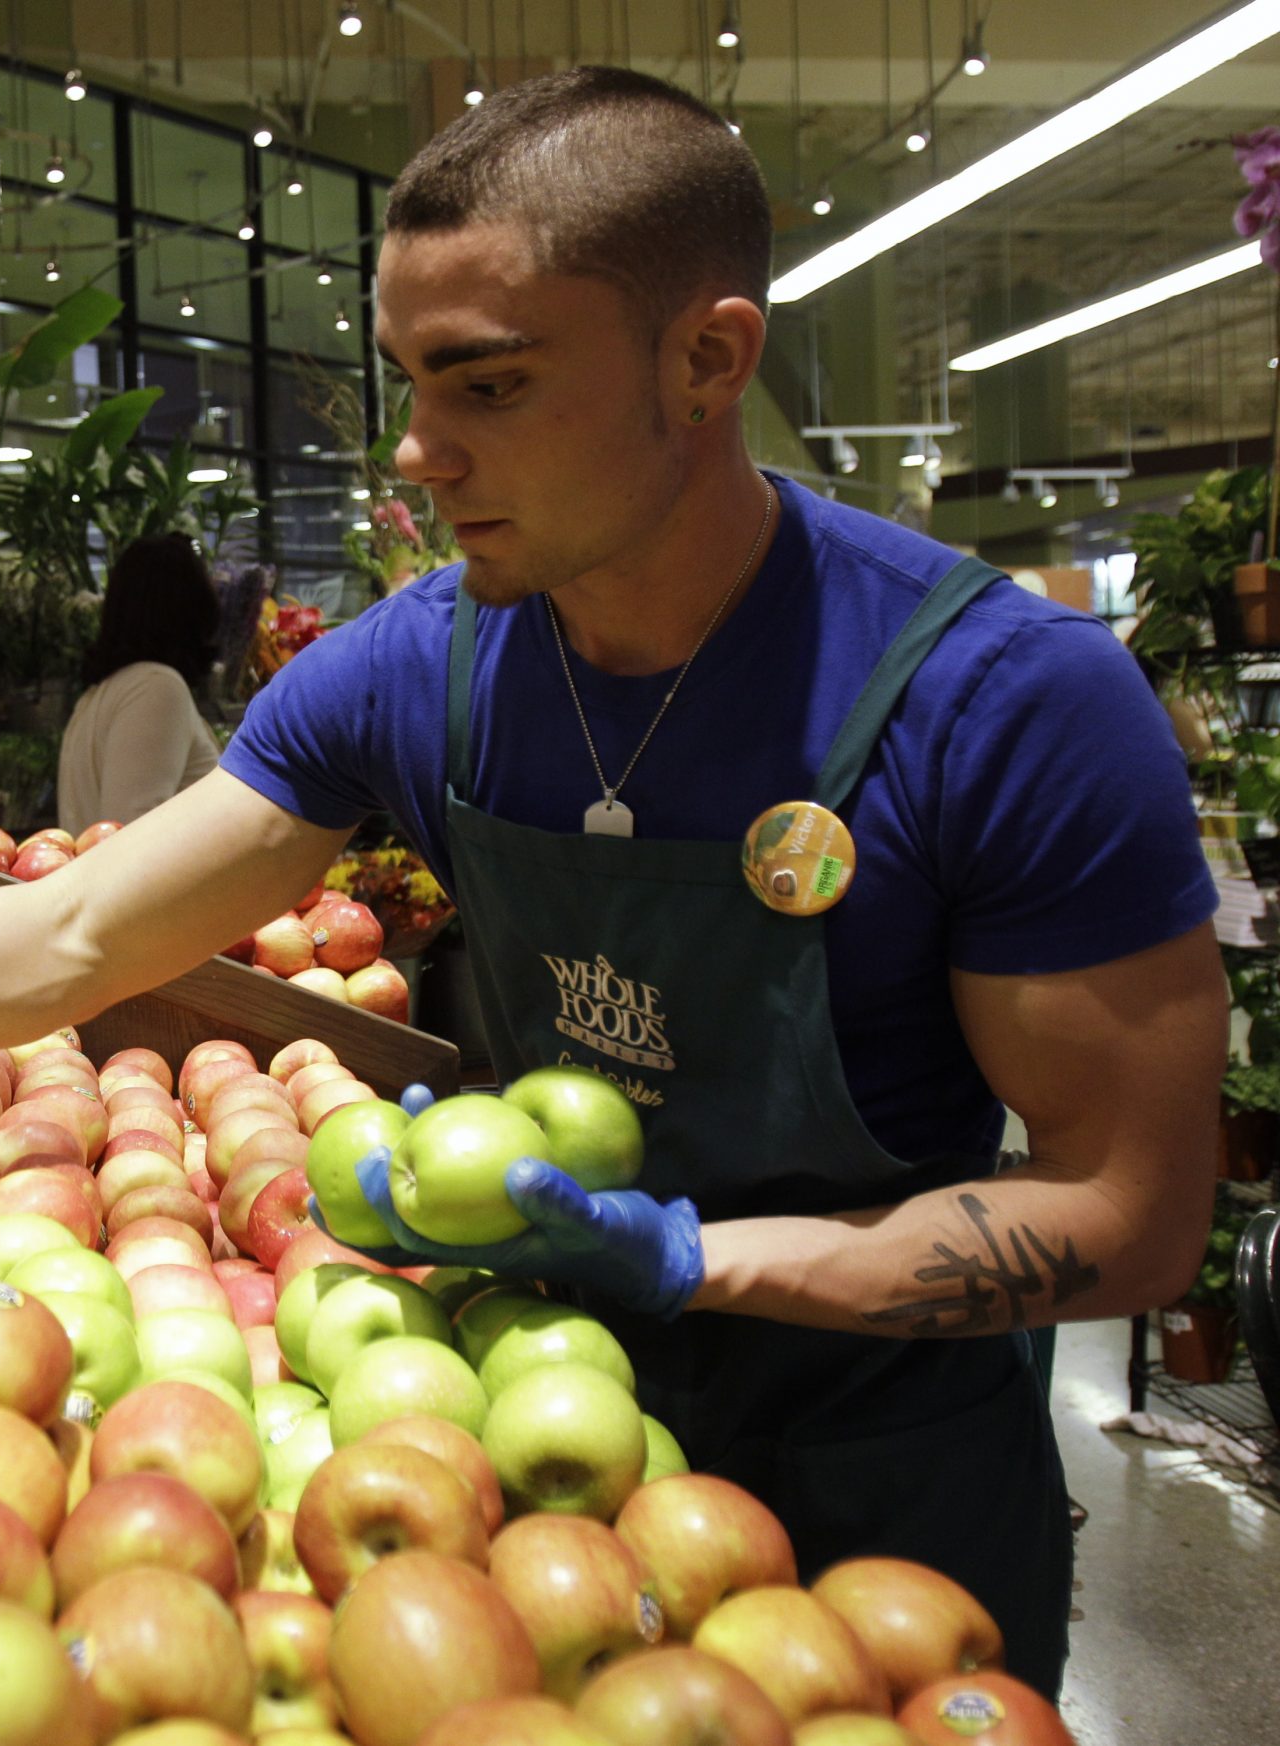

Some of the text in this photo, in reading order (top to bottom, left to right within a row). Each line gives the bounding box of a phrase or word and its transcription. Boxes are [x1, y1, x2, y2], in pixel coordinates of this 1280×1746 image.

[788, 810, 817, 855] Victor
[817, 857, 834, 894] ORGANIC
[540, 953, 666, 1021] WHOLE
[556, 985, 671, 1052] FOODS
